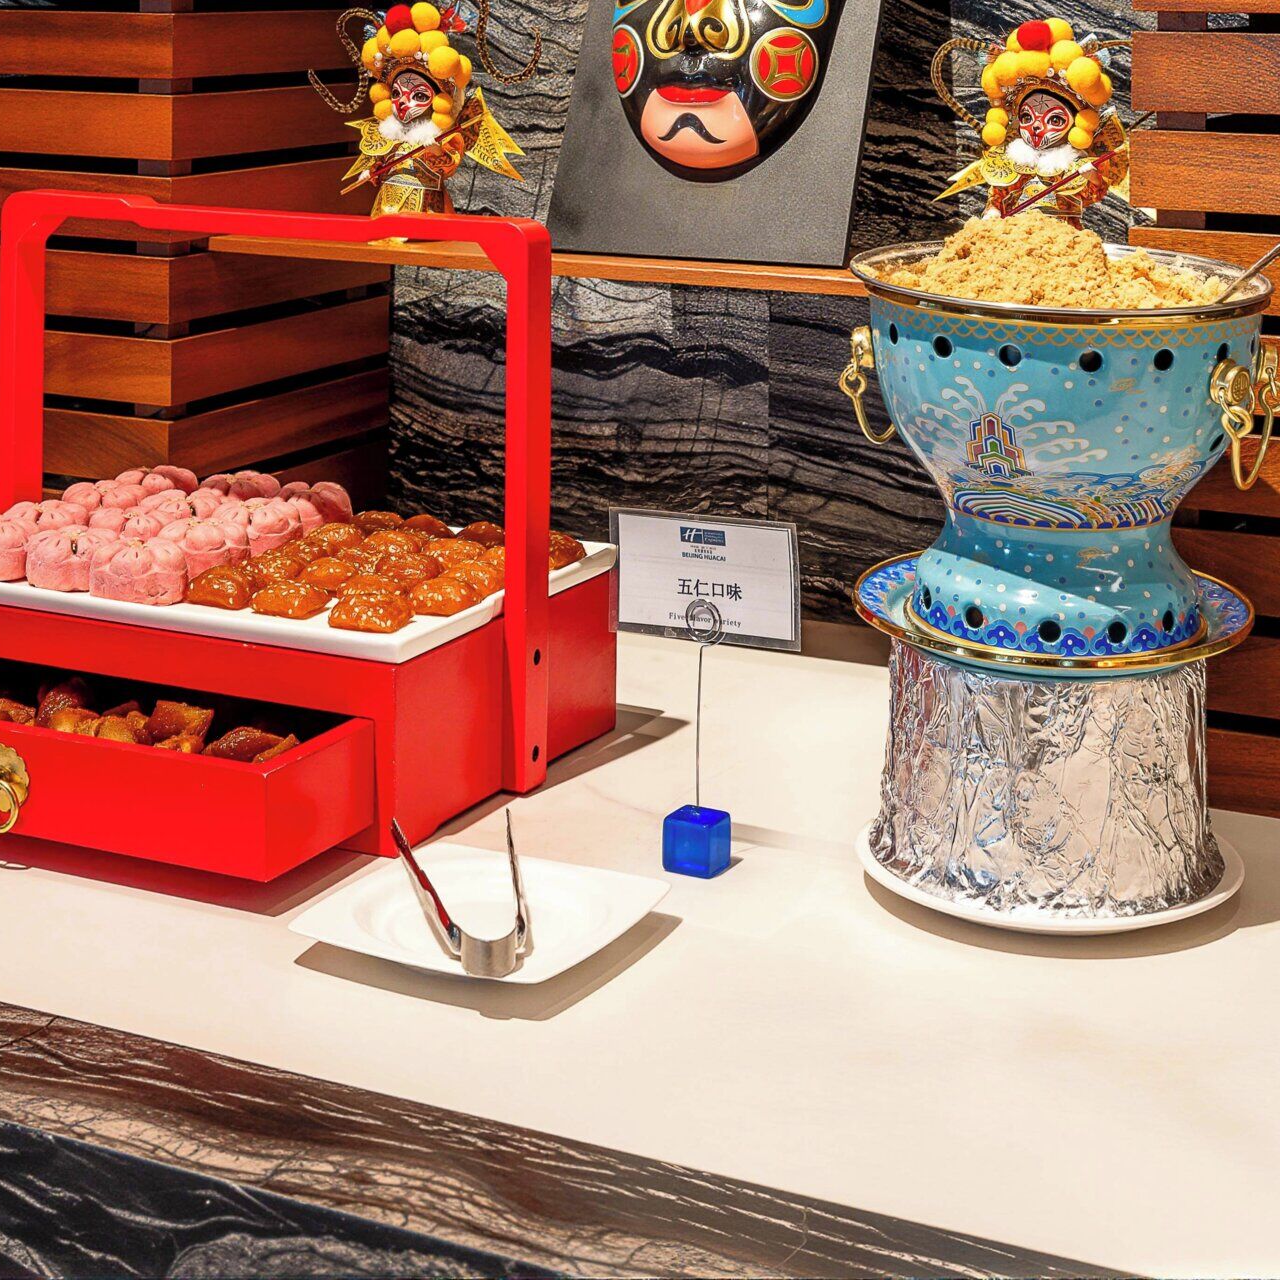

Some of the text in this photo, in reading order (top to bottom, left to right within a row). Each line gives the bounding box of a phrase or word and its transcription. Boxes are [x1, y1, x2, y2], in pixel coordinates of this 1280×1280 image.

[704, 554, 726, 562] HUACAI
[677, 578, 742, 601] 五仁口味
[668, 611, 685, 620] Five
